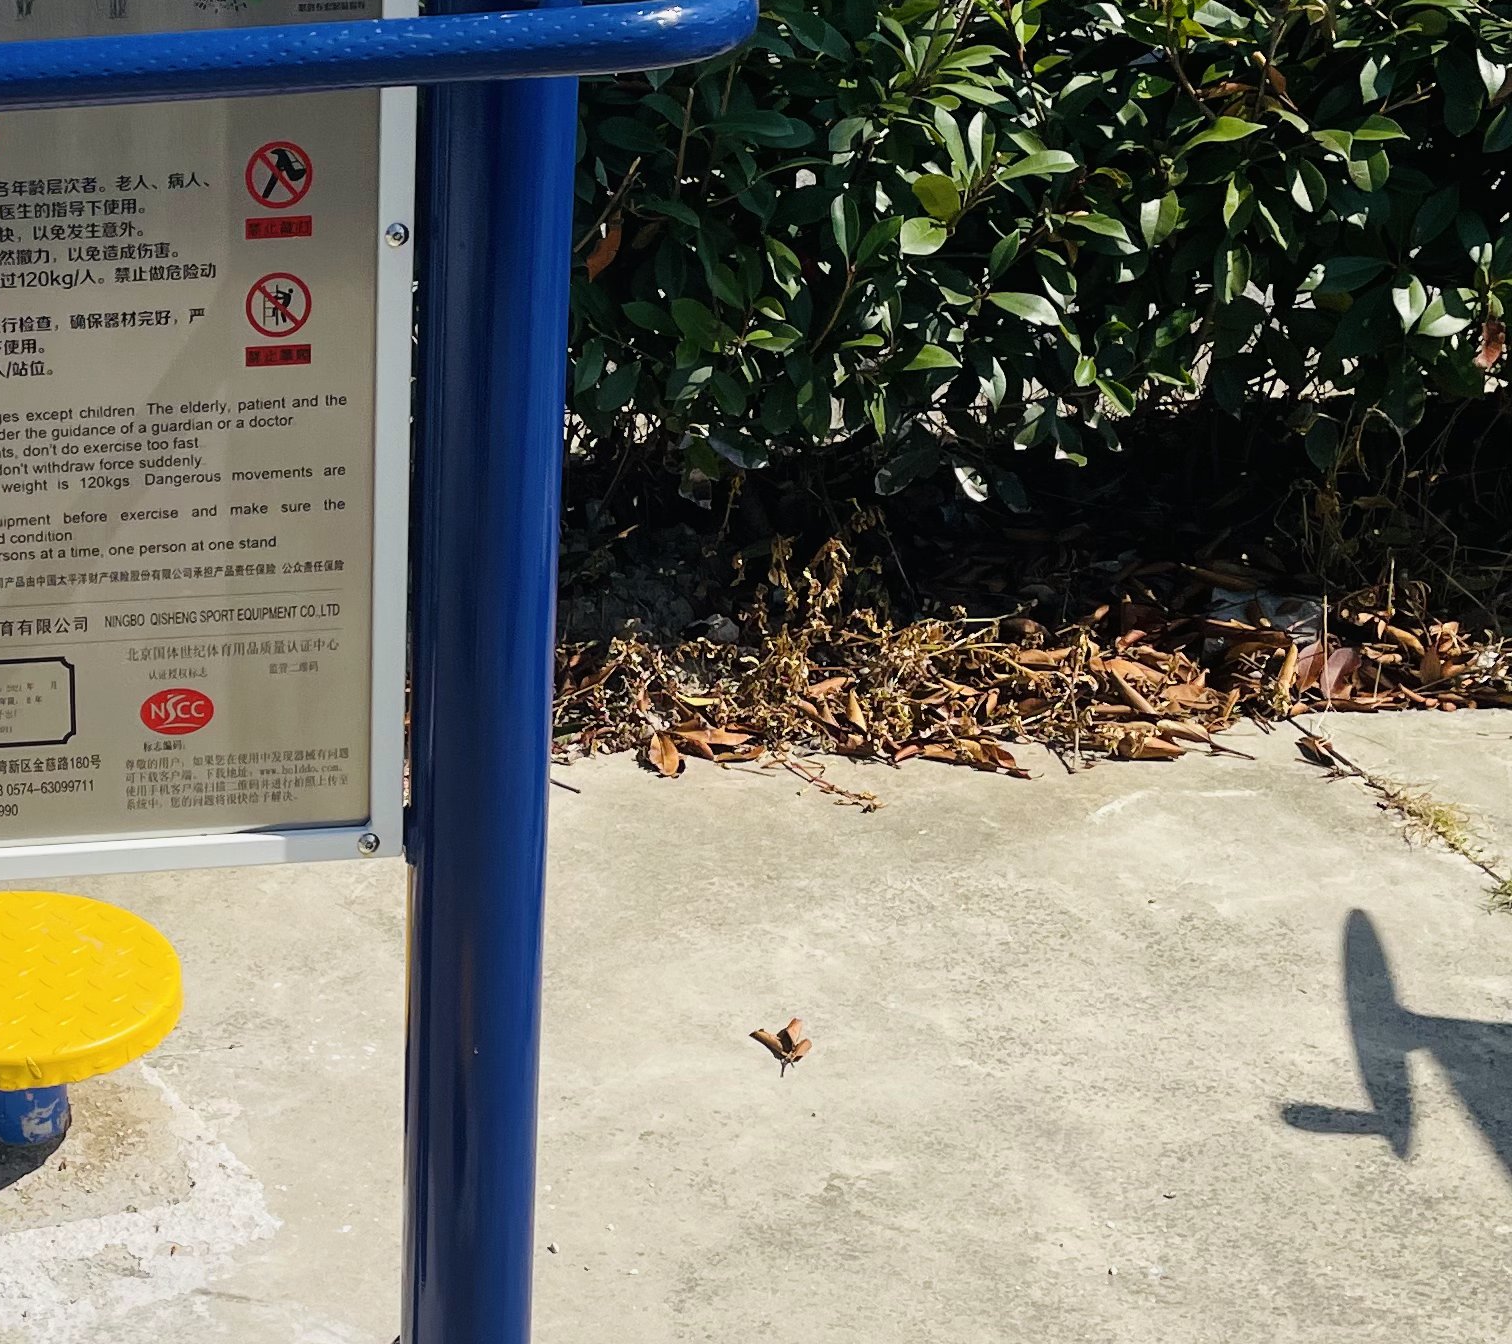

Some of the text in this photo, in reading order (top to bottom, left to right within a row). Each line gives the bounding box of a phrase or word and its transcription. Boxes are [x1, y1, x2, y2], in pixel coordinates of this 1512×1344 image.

[25, 407, 73, 424] except
[146, 402, 174, 416] The
[237, 396, 286, 414] patient
[291, 394, 319, 409] and
[325, 394, 347, 407] the
[24, 427, 48, 440] the
[51, 424, 116, 442] guidance
[120, 421, 135, 435] of
[138, 423, 147, 434] a
[151, 418, 213, 437] guardian
[217, 419, 233, 430] or
[235, 419, 245, 429] a
[22, 443, 58, 457] don't
[61, 442, 80, 455] do
[83, 441, 143, 455] exercise
[146, 439, 169, 451] too
[32, 460, 96, 474] withdraw
[99, 457, 135, 471] force
[1, 479, 48, 495] weight
[57, 480, 70, 490] is
[144, 472, 222, 488] Dangerous
[231, 466, 313, 481] movements
[323, 466, 346, 477] are
[63, 510, 108, 525] before
[120, 509, 179, 522] exercise
[191, 504, 218, 518] and
[230, 502, 269, 516] make
[280, 502, 312, 513] sure
[323, 498, 346, 511] the
[40, 547, 54, 560] at
[57, 549, 66, 559] a
[108, 545, 135, 556] one
[139, 542, 187, 557] person
[191, 539, 205, 552] at
[208, 540, 235, 551] one
[104, 613, 146, 628] NINGBO
[149, 610, 198, 626] QISHENG
[199, 608, 236, 623] SPORT
[236, 605, 298, 622] EQUIPMENT
[6, 779, 95, 796] 0574-63099711
